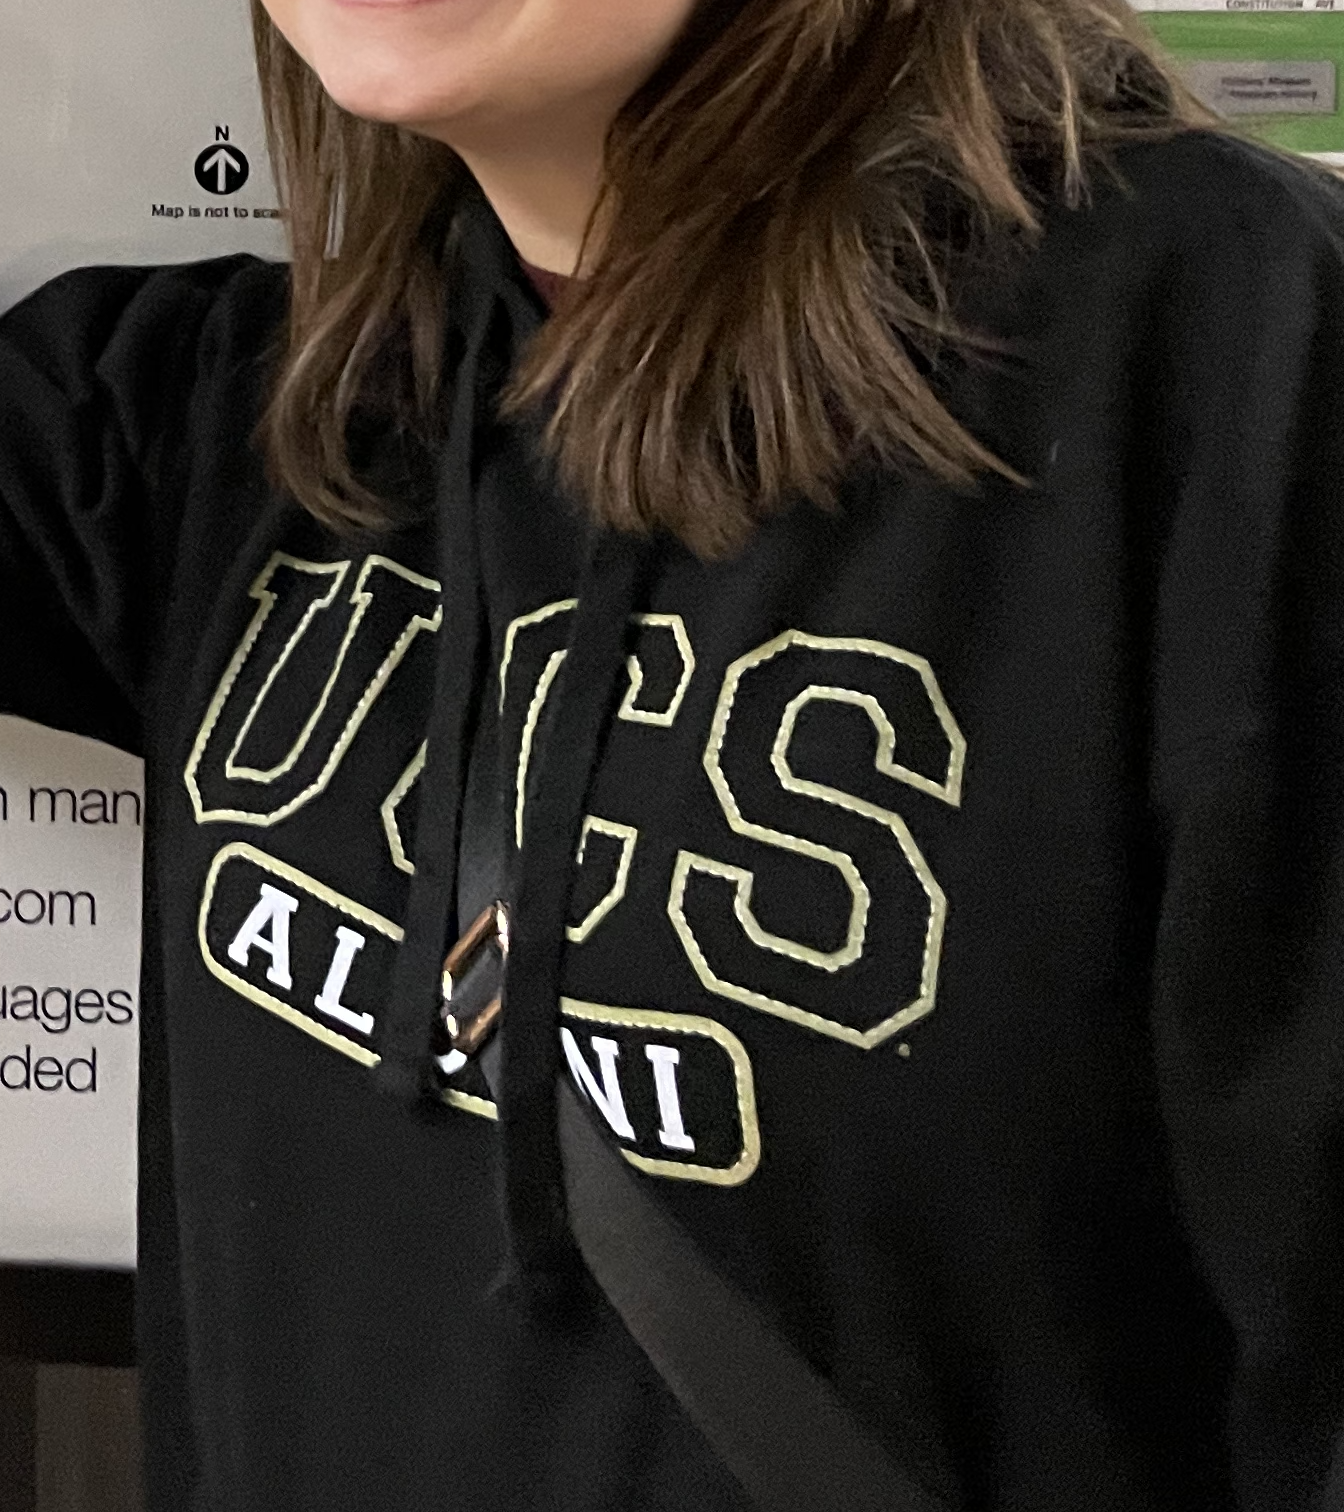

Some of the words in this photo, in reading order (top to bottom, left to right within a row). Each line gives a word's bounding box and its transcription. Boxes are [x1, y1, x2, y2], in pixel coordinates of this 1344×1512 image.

[216, 125, 229, 141] N
[152, 204, 184, 218] Map
[189, 205, 200, 217] is
[205, 207, 229, 217] not
[234, 207, 248, 218] to
[228, 882, 696, 1153] ALNI
